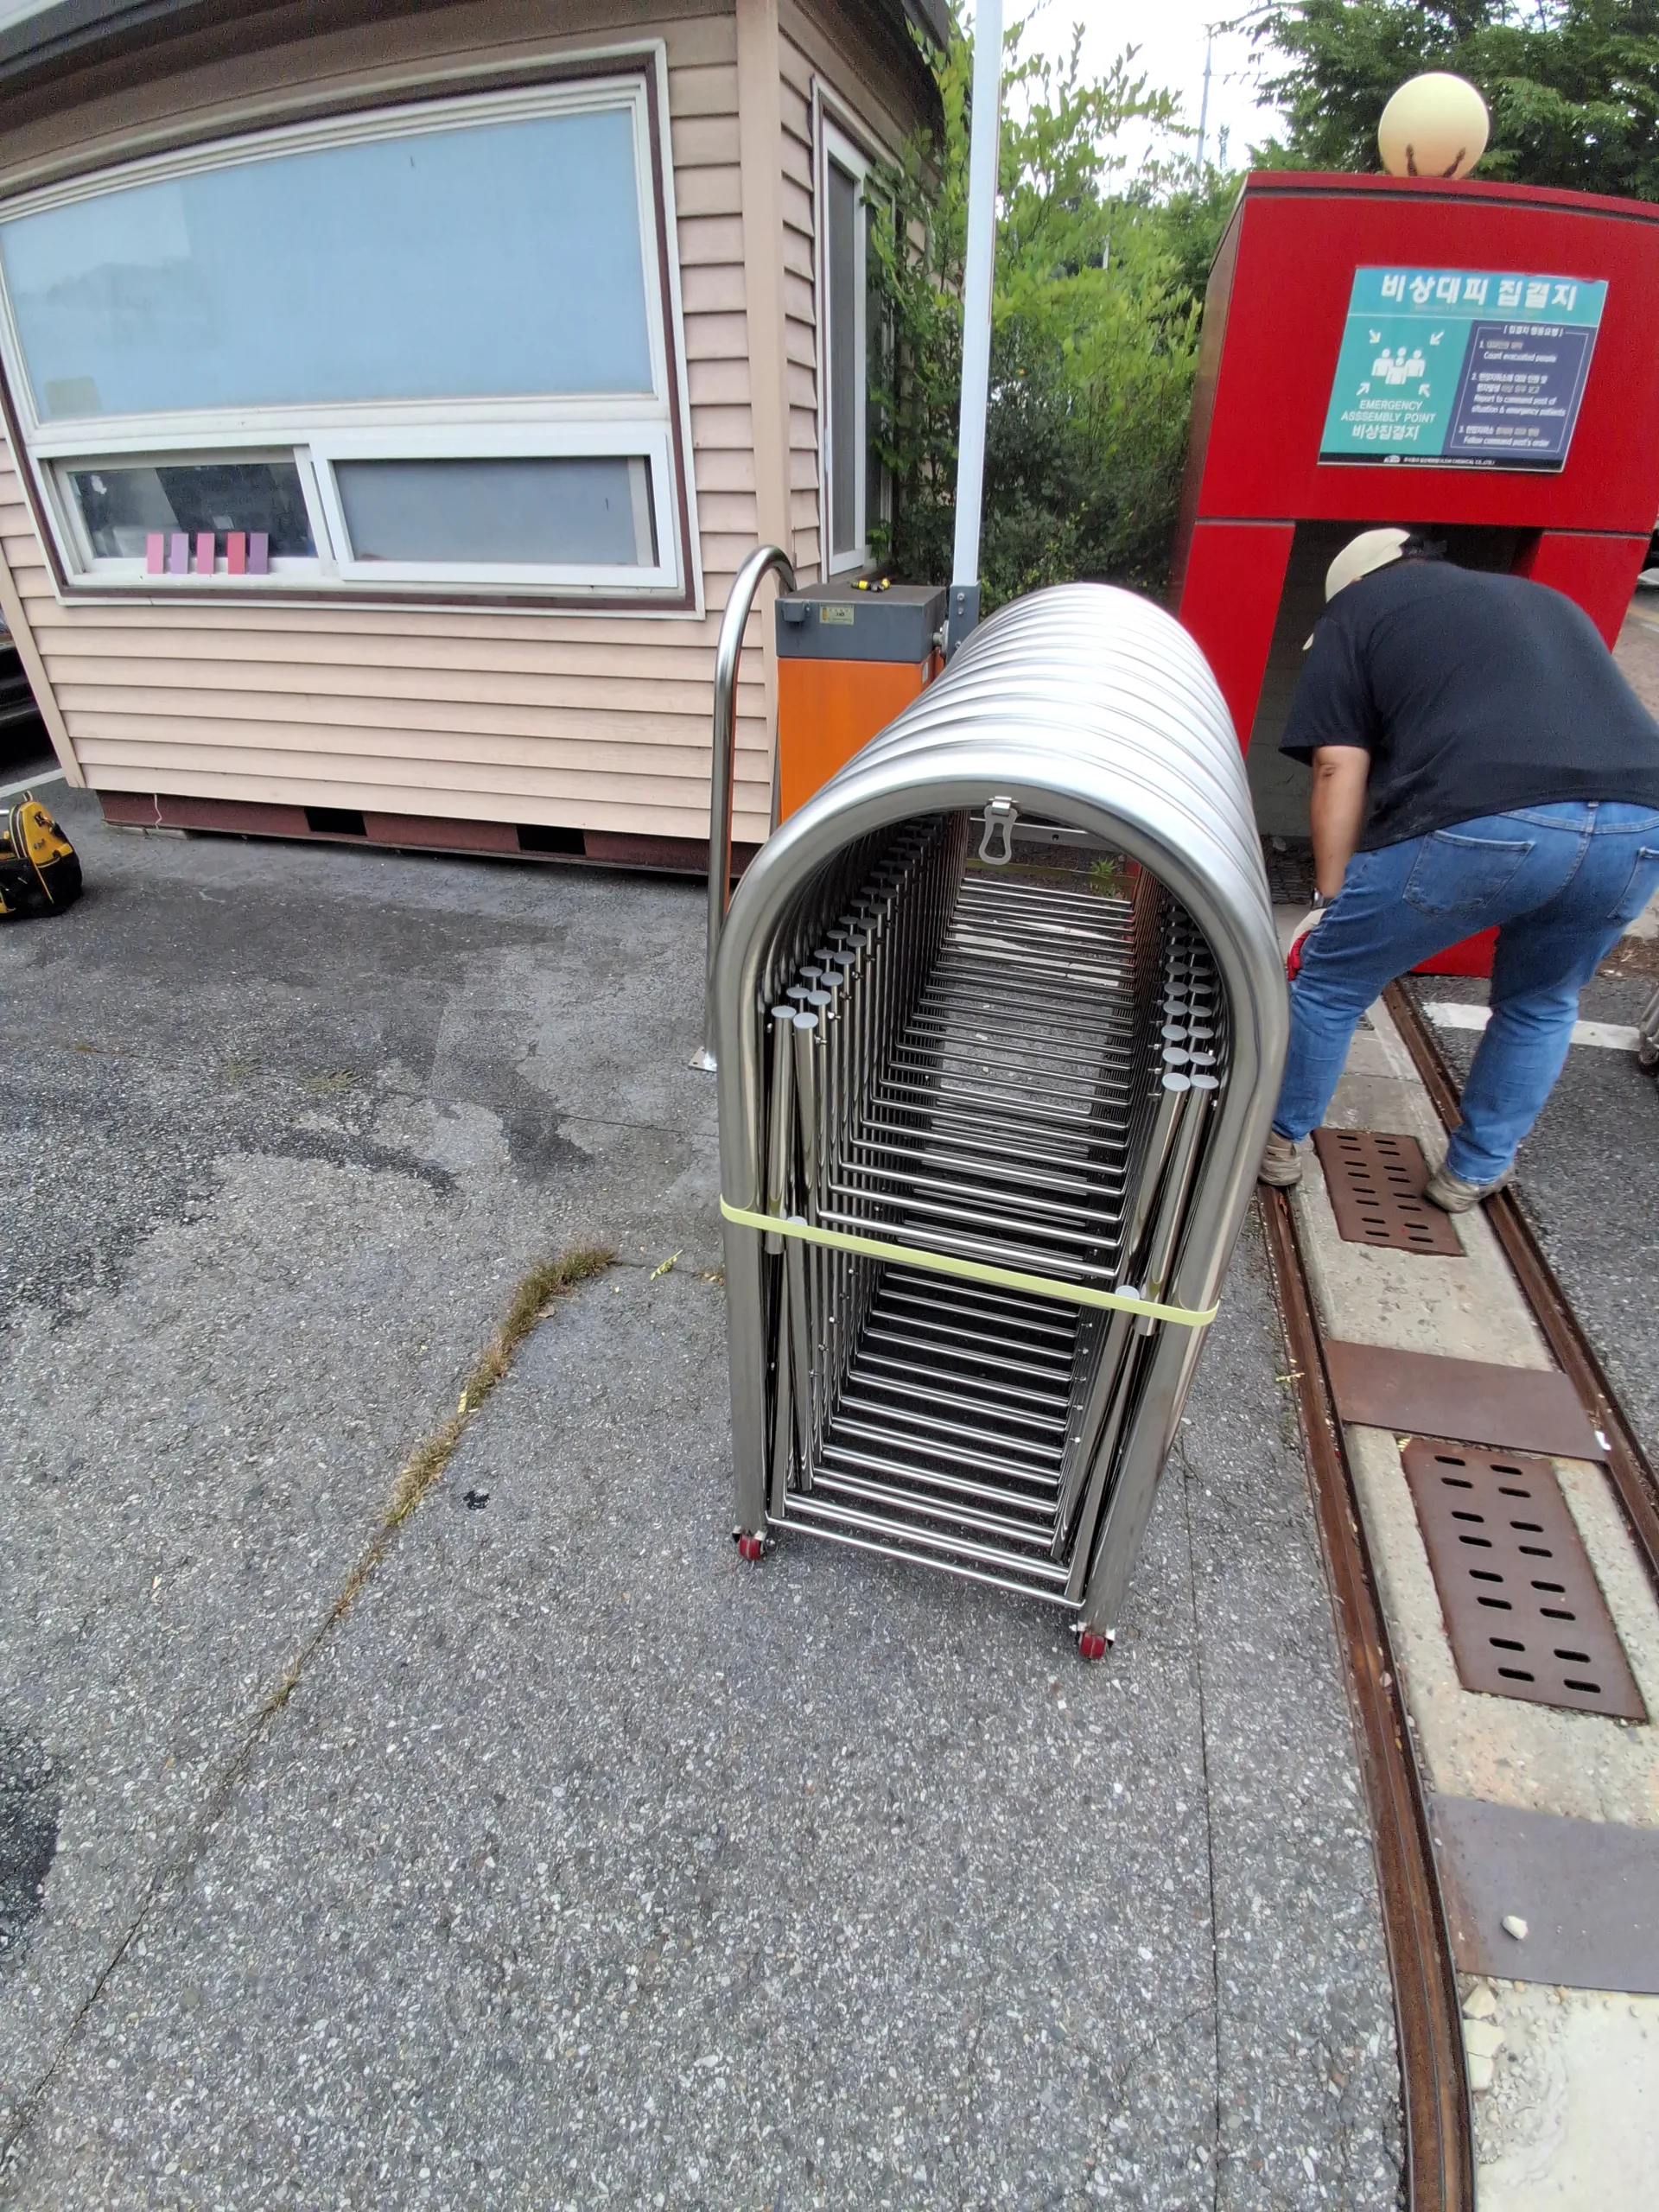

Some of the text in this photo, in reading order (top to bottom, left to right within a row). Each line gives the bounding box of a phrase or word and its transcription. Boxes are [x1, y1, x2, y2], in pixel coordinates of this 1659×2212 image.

[1381, 274, 1578, 312] 비상대피 집결지
[1359, 399, 1423, 410] EMERGENCY
[1404, 413, 1437, 423] POINT
[1352, 423, 1421, 441] 비상집결지
